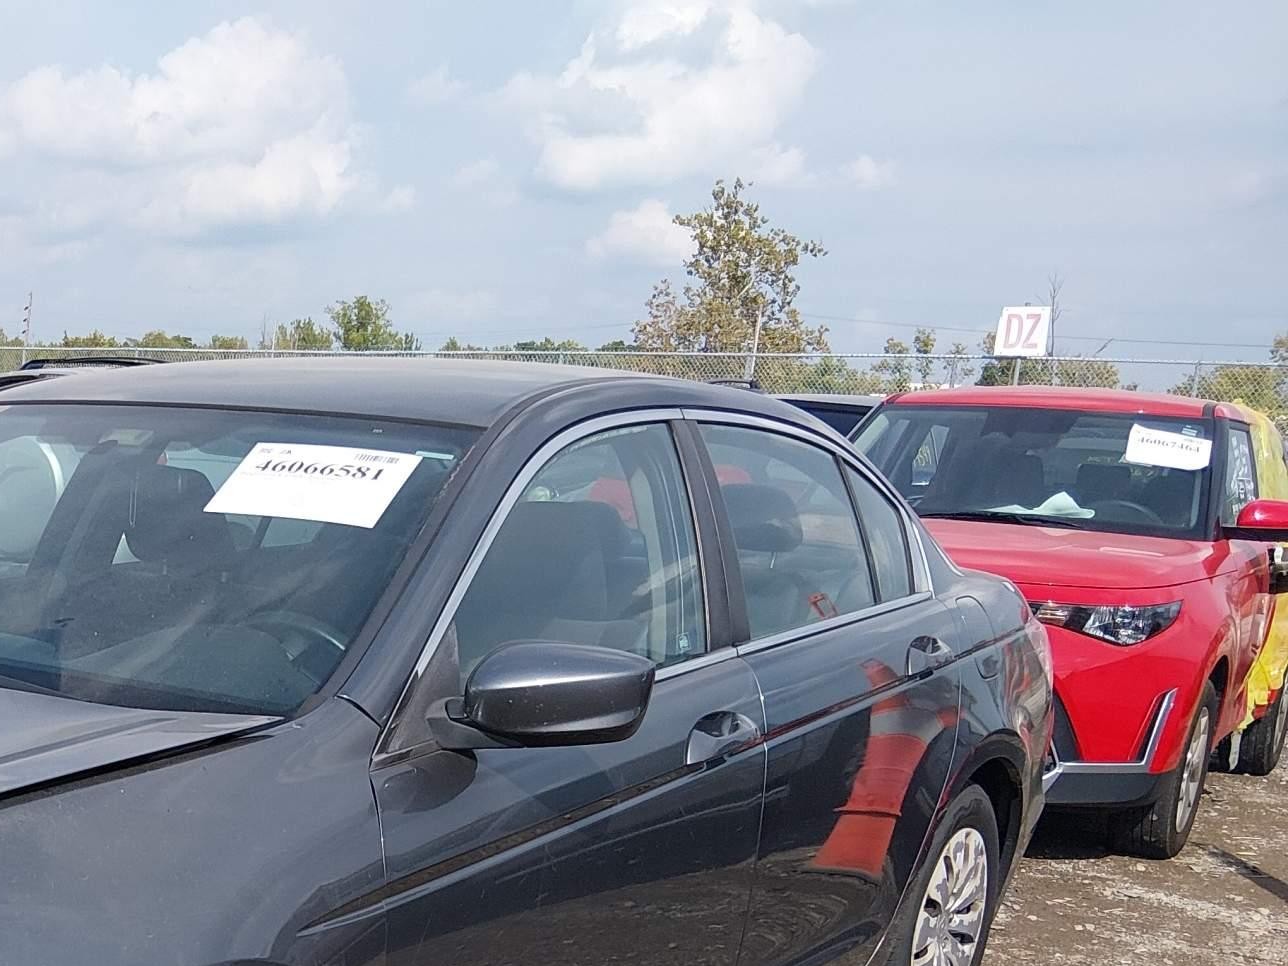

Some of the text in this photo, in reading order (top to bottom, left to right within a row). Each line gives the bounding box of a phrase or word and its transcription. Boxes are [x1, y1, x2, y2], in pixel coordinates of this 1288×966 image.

[1002, 313, 1042, 349] DZ
[1137, 436, 1201, 454] 46067464
[255, 459, 386, 482] 46066581
